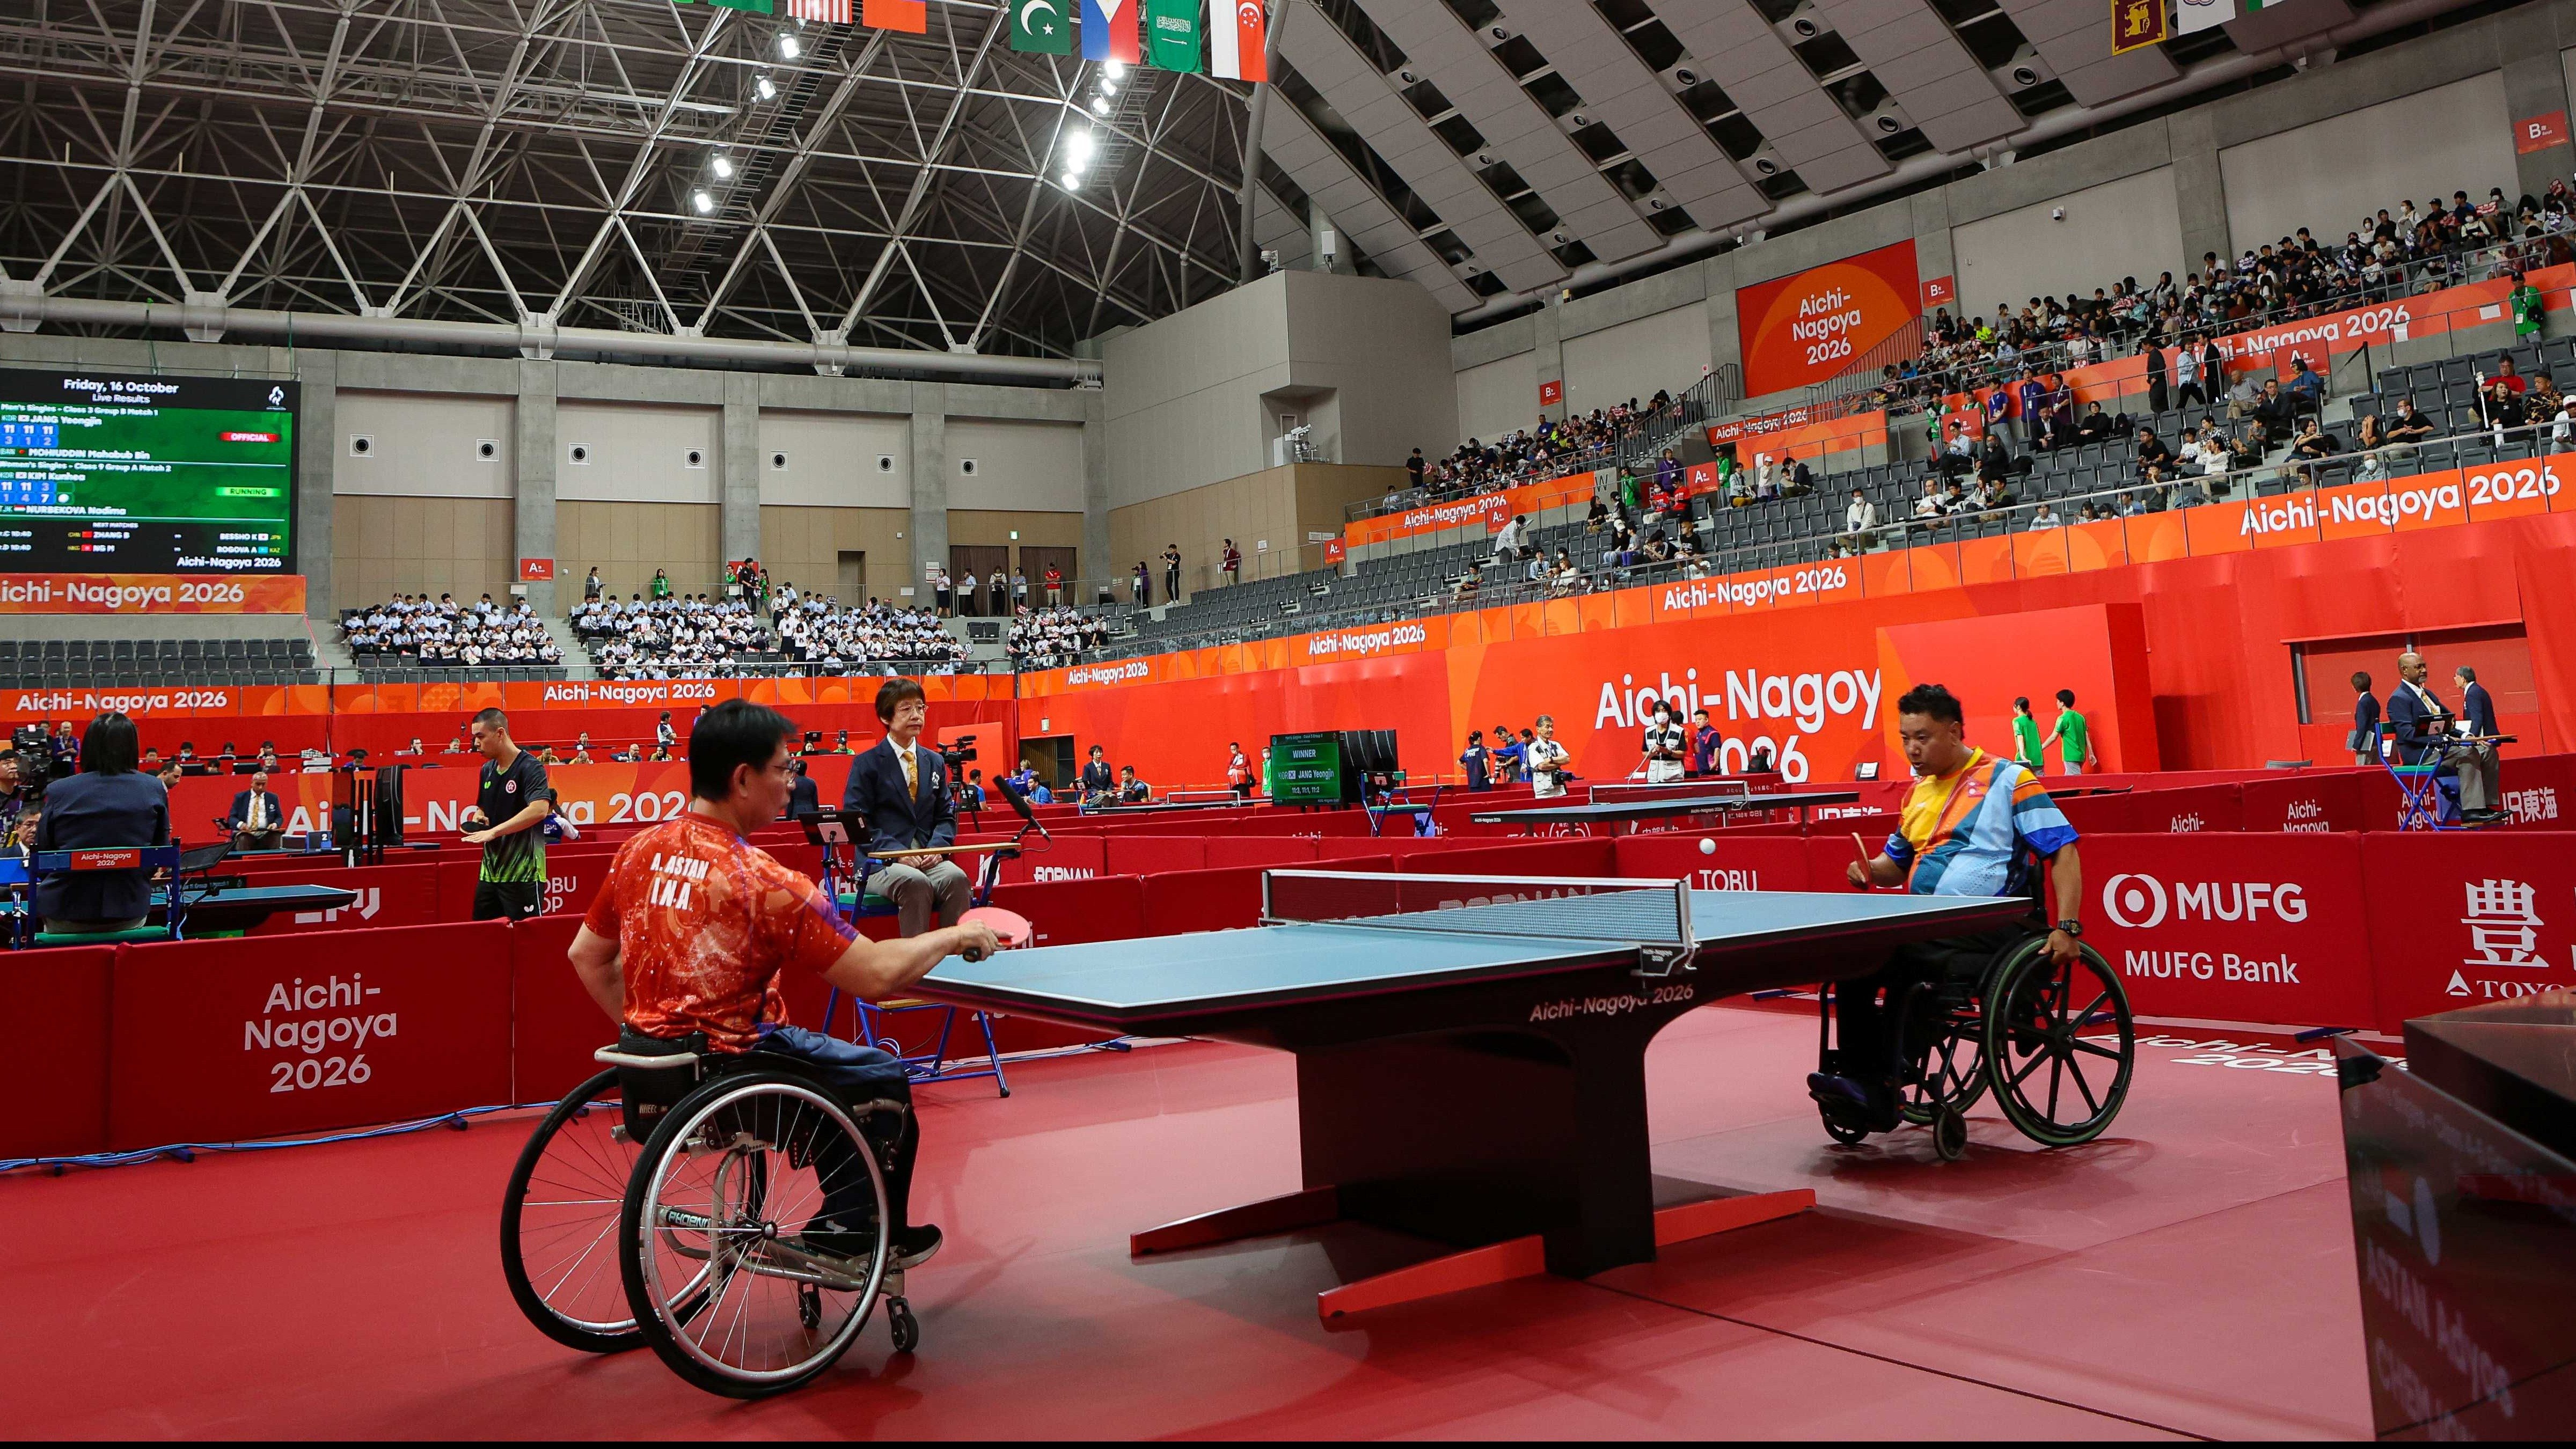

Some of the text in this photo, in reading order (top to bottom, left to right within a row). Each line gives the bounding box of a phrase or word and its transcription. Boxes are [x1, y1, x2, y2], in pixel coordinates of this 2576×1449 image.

[2529, 123, 2542, 138] B
[1930, 284, 1938, 296] B
[1799, 287, 1850, 318] Aichi-
[1792, 310, 1861, 341] Nagoya
[2346, 304, 2411, 338] 2026
[1806, 337, 1851, 365] 2026
[64, 378, 179, 394] Friday, 16 October
[92, 393, 150, 404] Live Results
[27, 404, 56, 413] Singles
[94, 407, 119, 416] Group
[4, 425, 54, 435] 11 11 11
[31, 415, 58, 423] JANG
[61, 416, 102, 427] Yeongjin
[5, 436, 52, 446] 3 1 2
[230, 433, 269, 442] OFFICIAL
[38, 462, 68, 471] Singles
[105, 464, 130, 472] Group
[1695, 470, 1703, 484] A
[2, 482, 12, 491] 11
[21, 482, 32, 491] 11
[3, 494, 49, 503] 1 4 7
[2240, 466, 2560, 536] Aichi-Nagoya 2026
[26, 506, 86, 514] NURBEKOVA
[1404, 503, 1476, 529] Aichi-Nagoya
[176, 557, 282, 570] Aichi-Nagoya 2026
[529, 562, 538, 573] A
[0, 580, 245, 609] ichi-Nagoya 2026
[1664, 566, 1846, 611] Aichi-Nagoya 2026
[1308, 624, 1425, 655] Aichi-Nagoya 2026
[1068, 661, 1148, 685] Aichi-Nagoya 2026
[16, 691, 228, 713] Aichi-Nagoya 2026
[544, 683, 715, 705] Aichi-Nagoya 2026
[1595, 667, 1881, 733] Aichi-Nagoy
[1293, 749, 1316, 758] WINNER
[1313, 769, 1334, 780] Yeongjin
[609, 792, 691, 823] 202
[2288, 799, 2322, 819] Aichi-
[2171, 812, 2205, 833] Aichi-
[81, 853, 131, 861] Aichi-Nagoya
[1699, 869, 1757, 891] TOBU
[2175, 883, 2308, 922] MUFG
[2125, 950, 2300, 984] MUFG Bank
[264, 972, 380, 1013] Aichi-
[1529, 984, 1694, 1022] Aichi-Nagoya 2026
[244, 1013, 397, 1054] Nagoya
[270, 1054, 371, 1093] 2026
